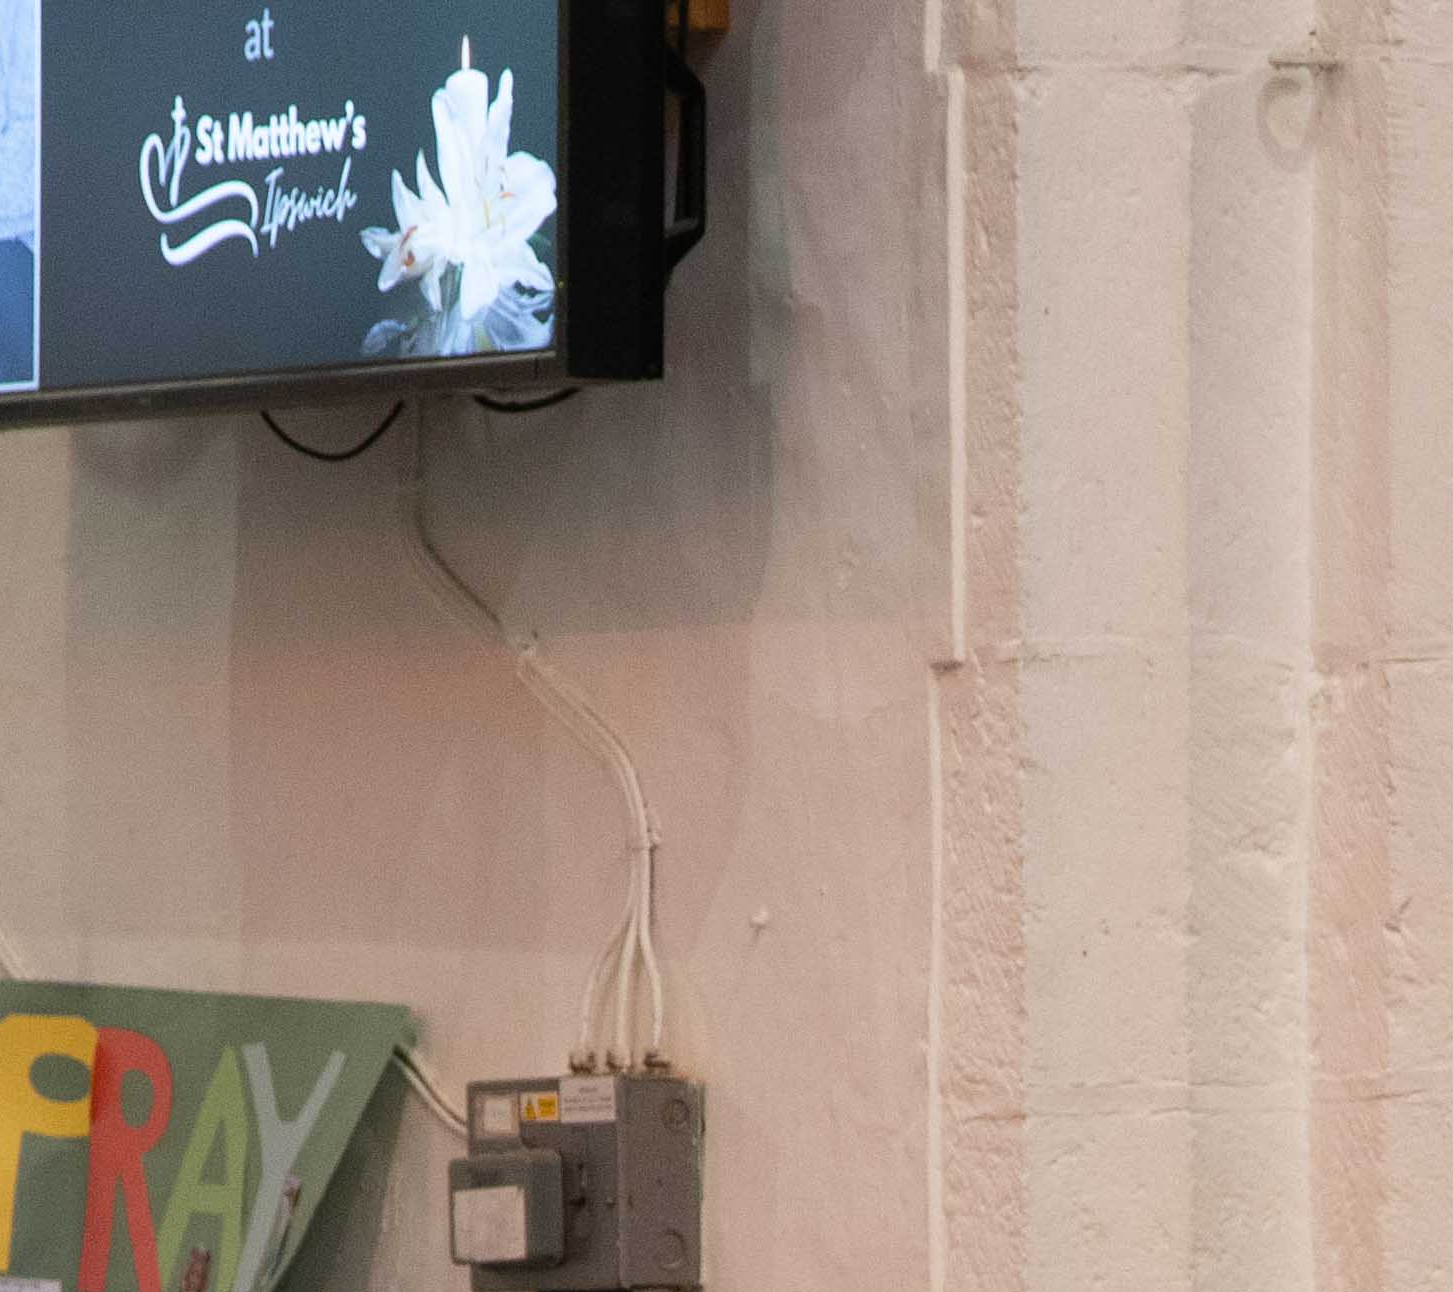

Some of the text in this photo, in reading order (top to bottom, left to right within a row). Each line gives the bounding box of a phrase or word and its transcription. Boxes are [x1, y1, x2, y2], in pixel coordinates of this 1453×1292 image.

[244, 8, 274, 61] at
[195, 99, 366, 165] St Matthew's
[260, 156, 357, 248] Ipswich
